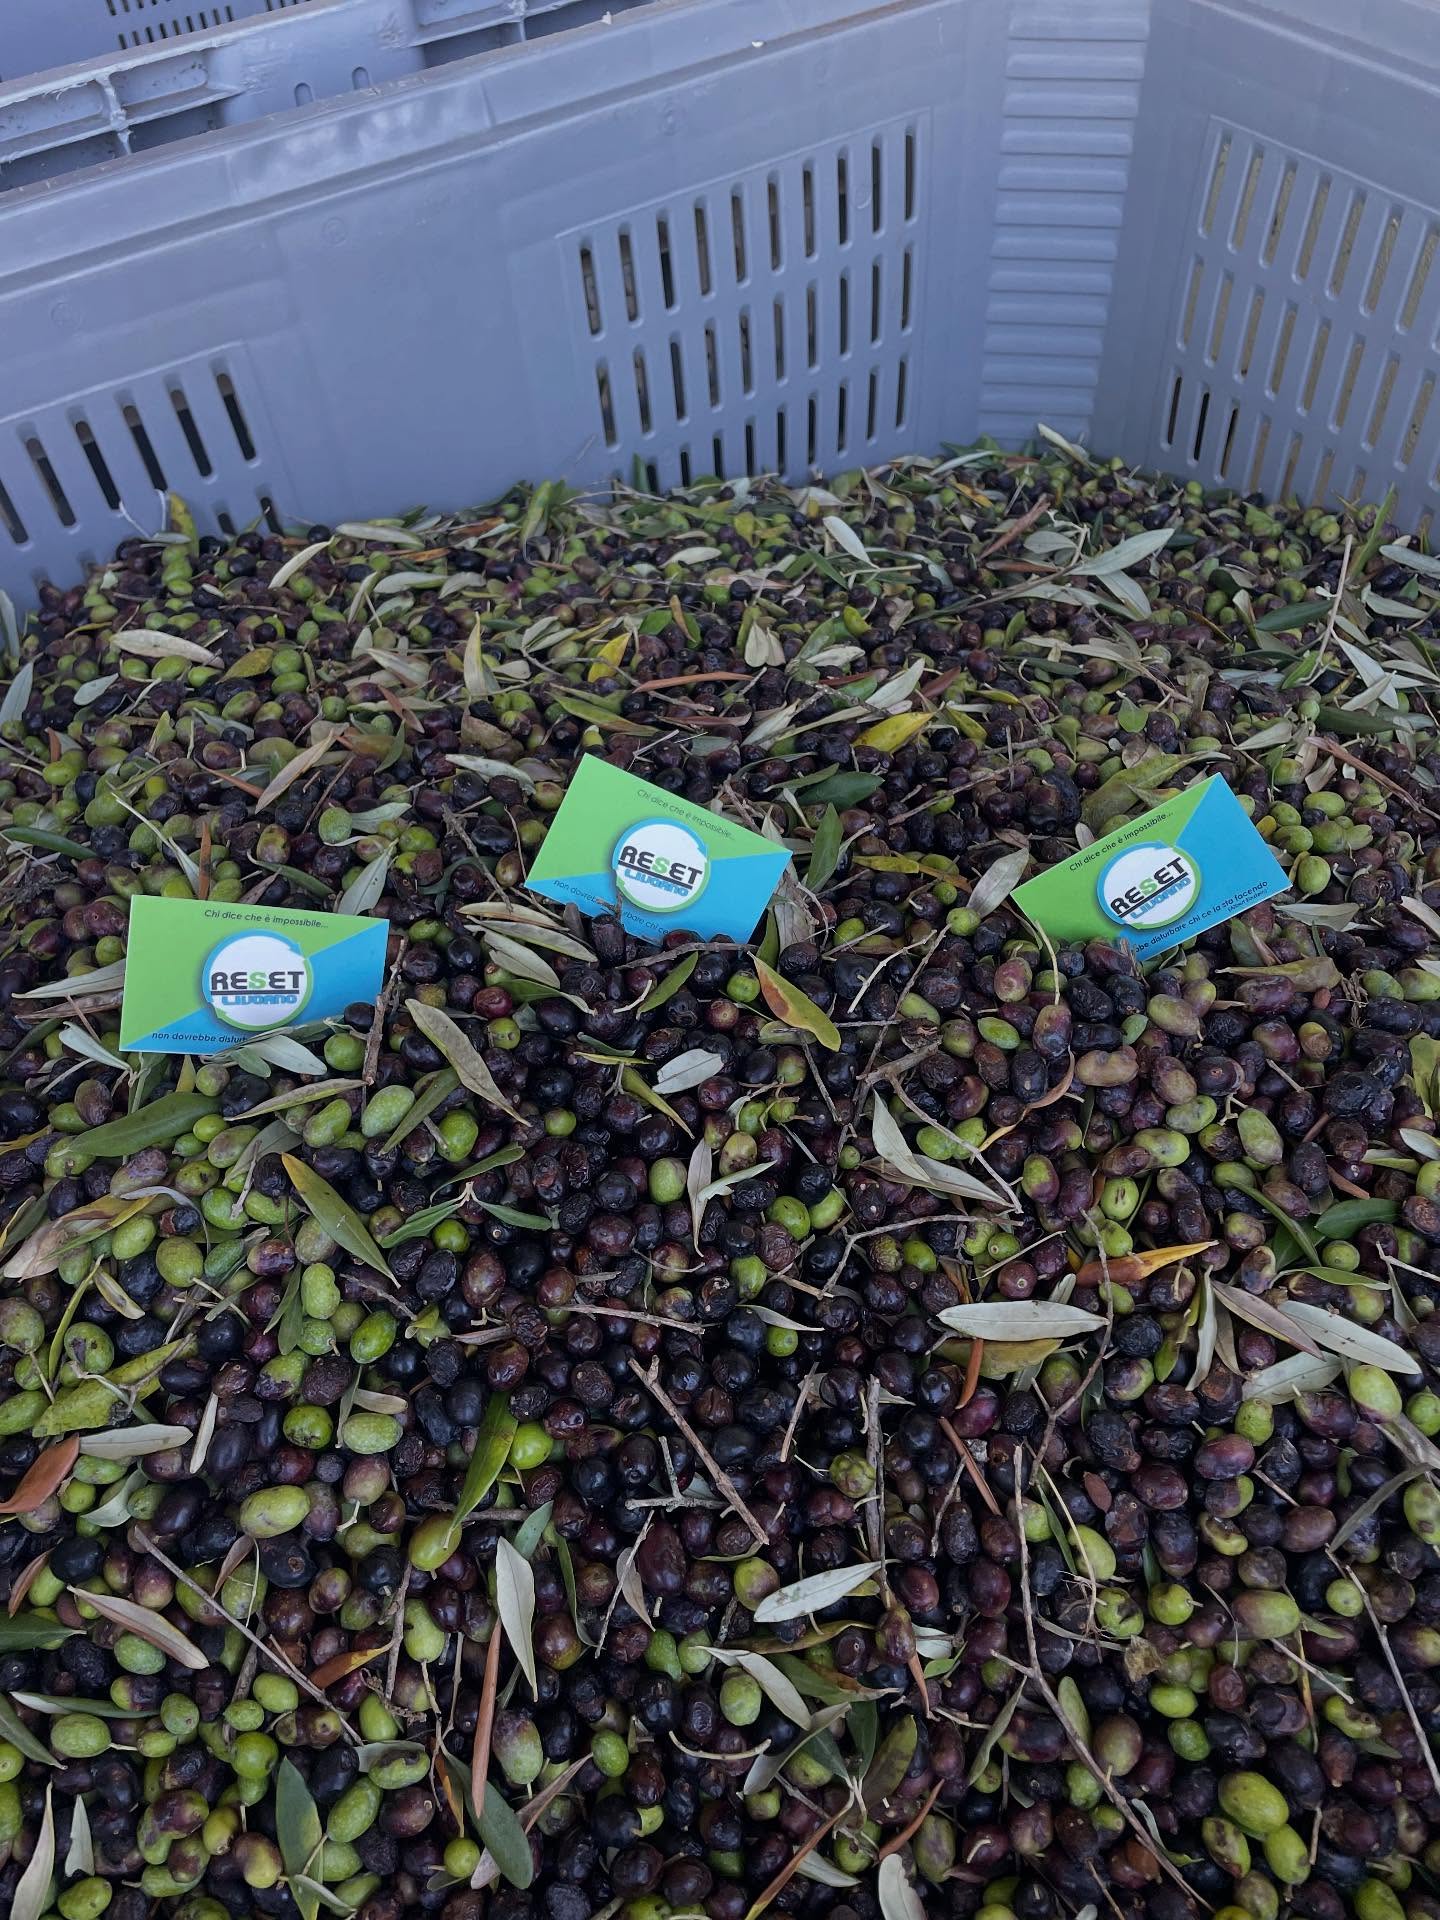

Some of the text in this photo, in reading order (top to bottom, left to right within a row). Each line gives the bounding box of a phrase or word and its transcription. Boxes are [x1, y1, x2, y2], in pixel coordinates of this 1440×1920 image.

[637, 789, 650, 800] Chi
[650, 796, 669, 809] dice
[669, 805, 685, 816] che
[619, 845, 703, 885] RESET
[1069, 861, 1083, 872] Chi
[1083, 850, 1101, 864] dice
[1101, 841, 1116, 854] che
[1110, 857, 1185, 915] RESET
[204, 909, 221, 918] Chi
[222, 911, 242, 920] dice
[244, 914, 262, 922] che
[553, 880, 569, 891] non
[645, 921, 658, 930] chi
[1151, 922, 1187, 945] disturbare
[1188, 914, 1201, 925] chi
[1201, 908, 1213, 918] ce
[1213, 904, 1221, 913] la
[1221, 898, 1234, 909] sta
[1234, 881, 1268, 901] facendo
[211, 971, 305, 991] RESET
[151, 1031, 169, 1040] non
[171, 1032, 217, 1042] dovrebbe
